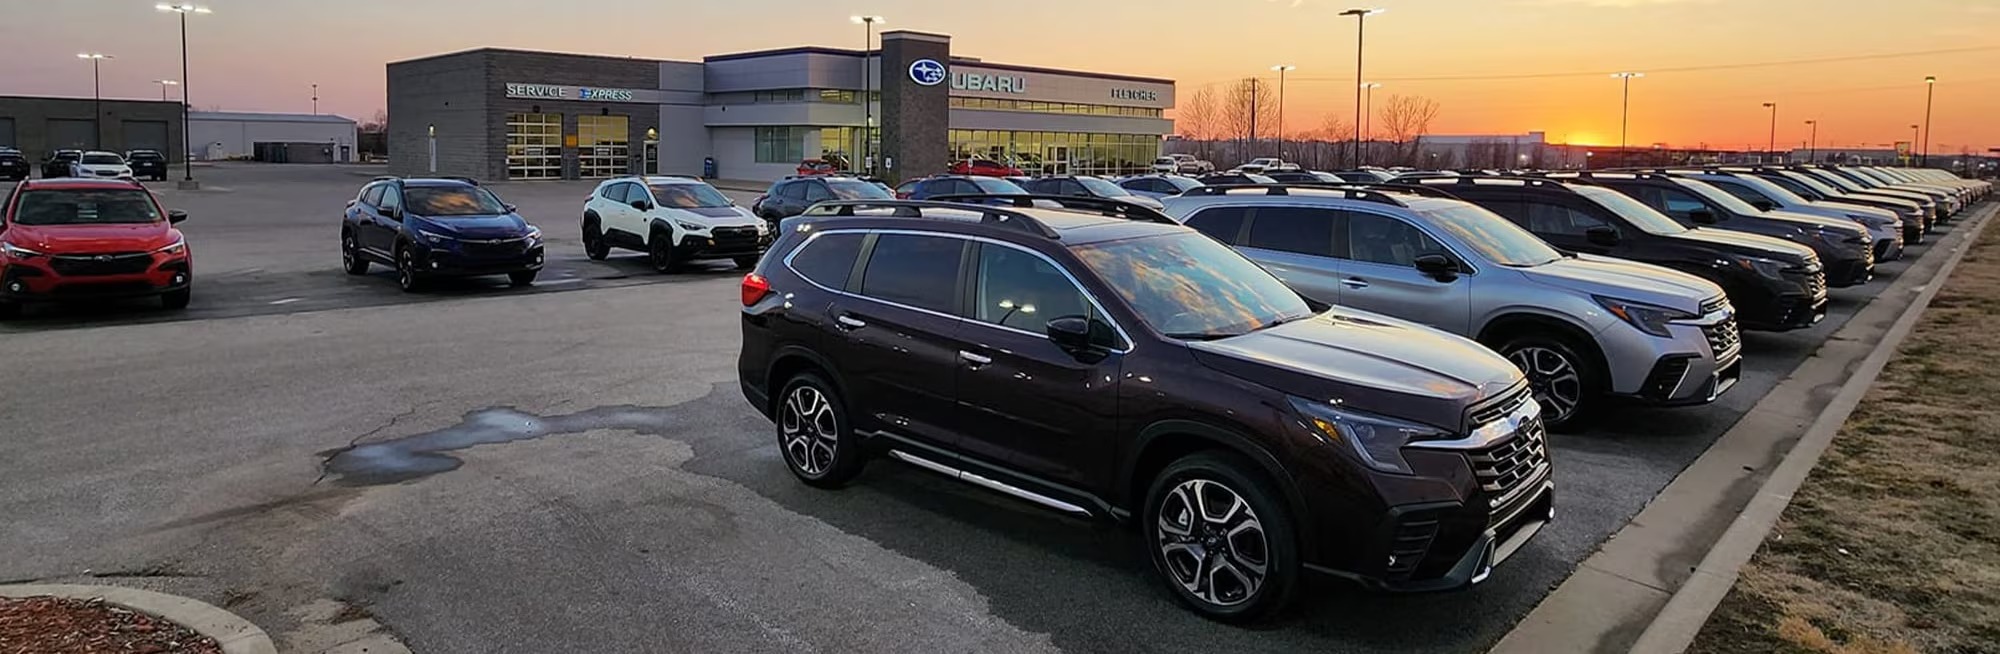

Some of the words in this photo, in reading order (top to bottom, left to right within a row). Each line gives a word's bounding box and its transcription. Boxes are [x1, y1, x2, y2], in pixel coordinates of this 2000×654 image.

[948, 72, 1026, 93] UBARU
[506, 84, 568, 98] SERVICE
[579, 86, 632, 101] EXPRESS
[1111, 88, 1156, 101] FLETCHER
